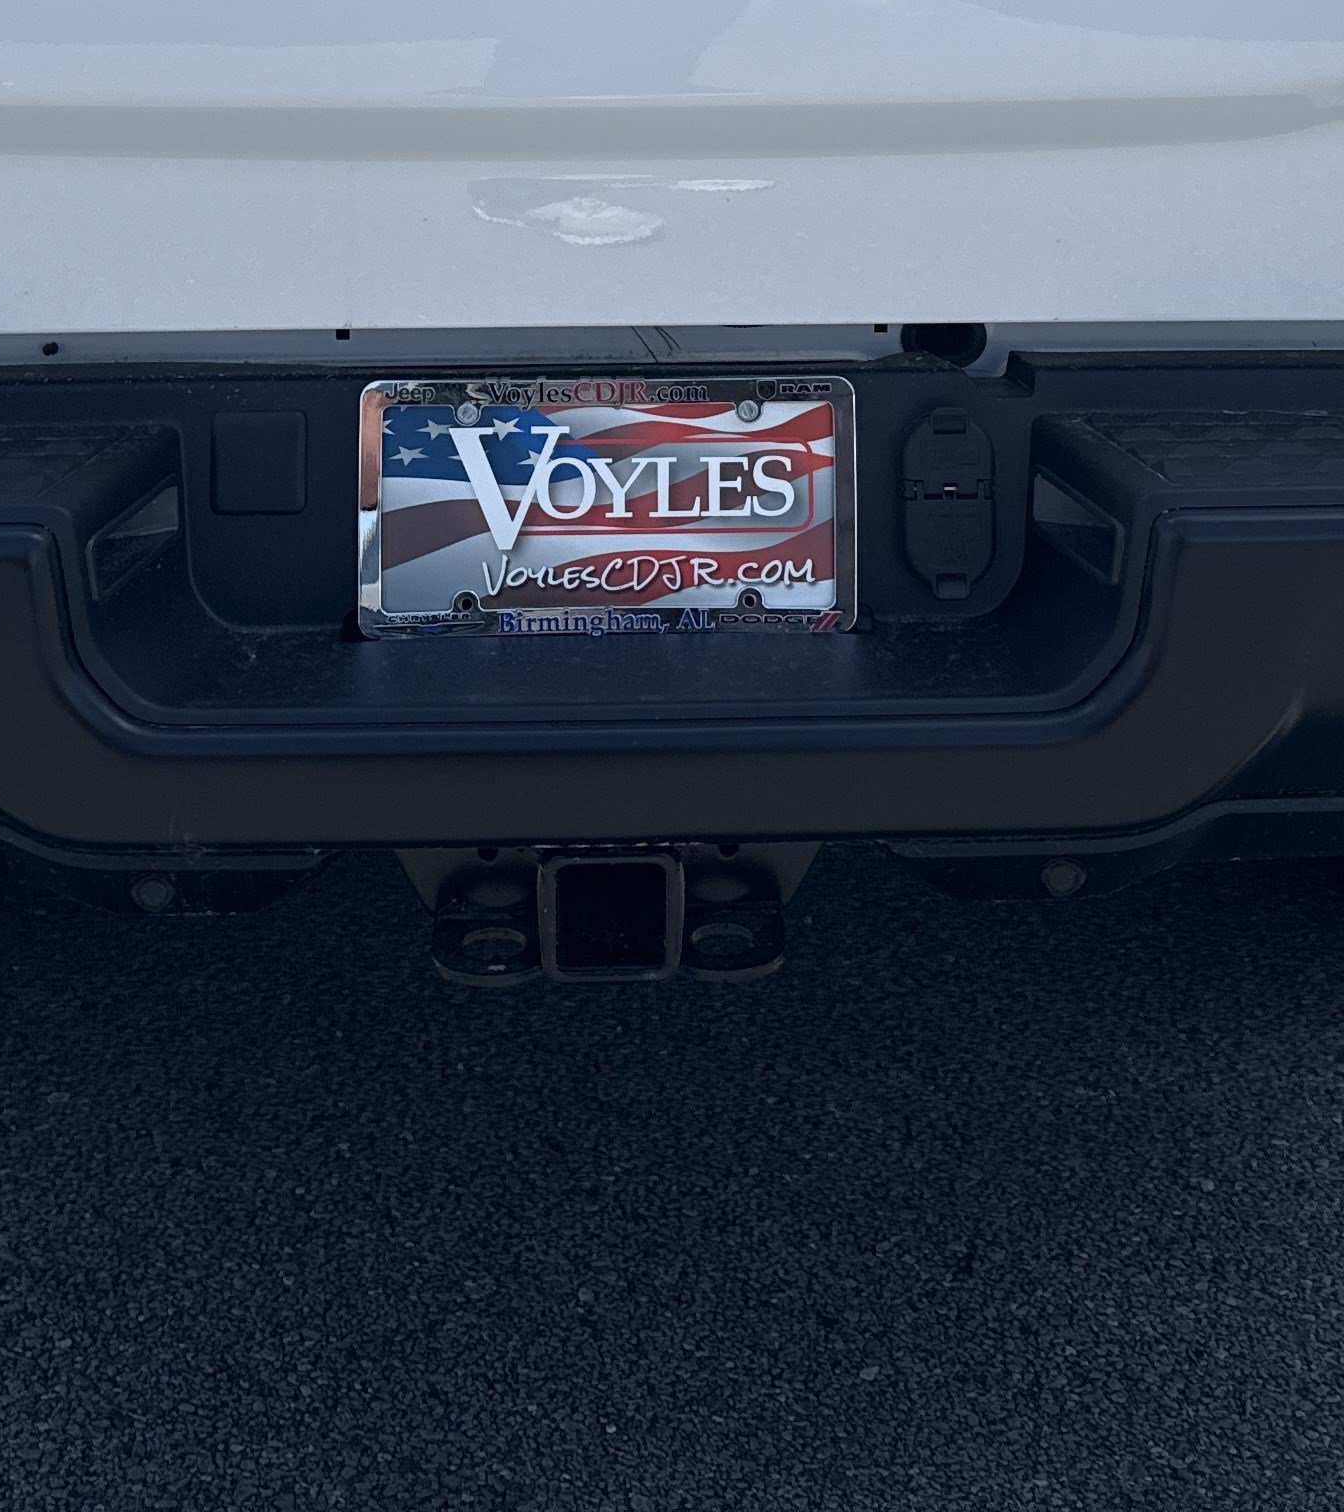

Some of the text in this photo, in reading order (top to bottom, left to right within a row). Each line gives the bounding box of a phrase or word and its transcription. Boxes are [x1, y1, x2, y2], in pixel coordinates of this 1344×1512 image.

[385, 384, 435, 402] Jeep
[781, 383, 831, 393] RAM
[498, 609, 716, 635] Birmingham, AL
